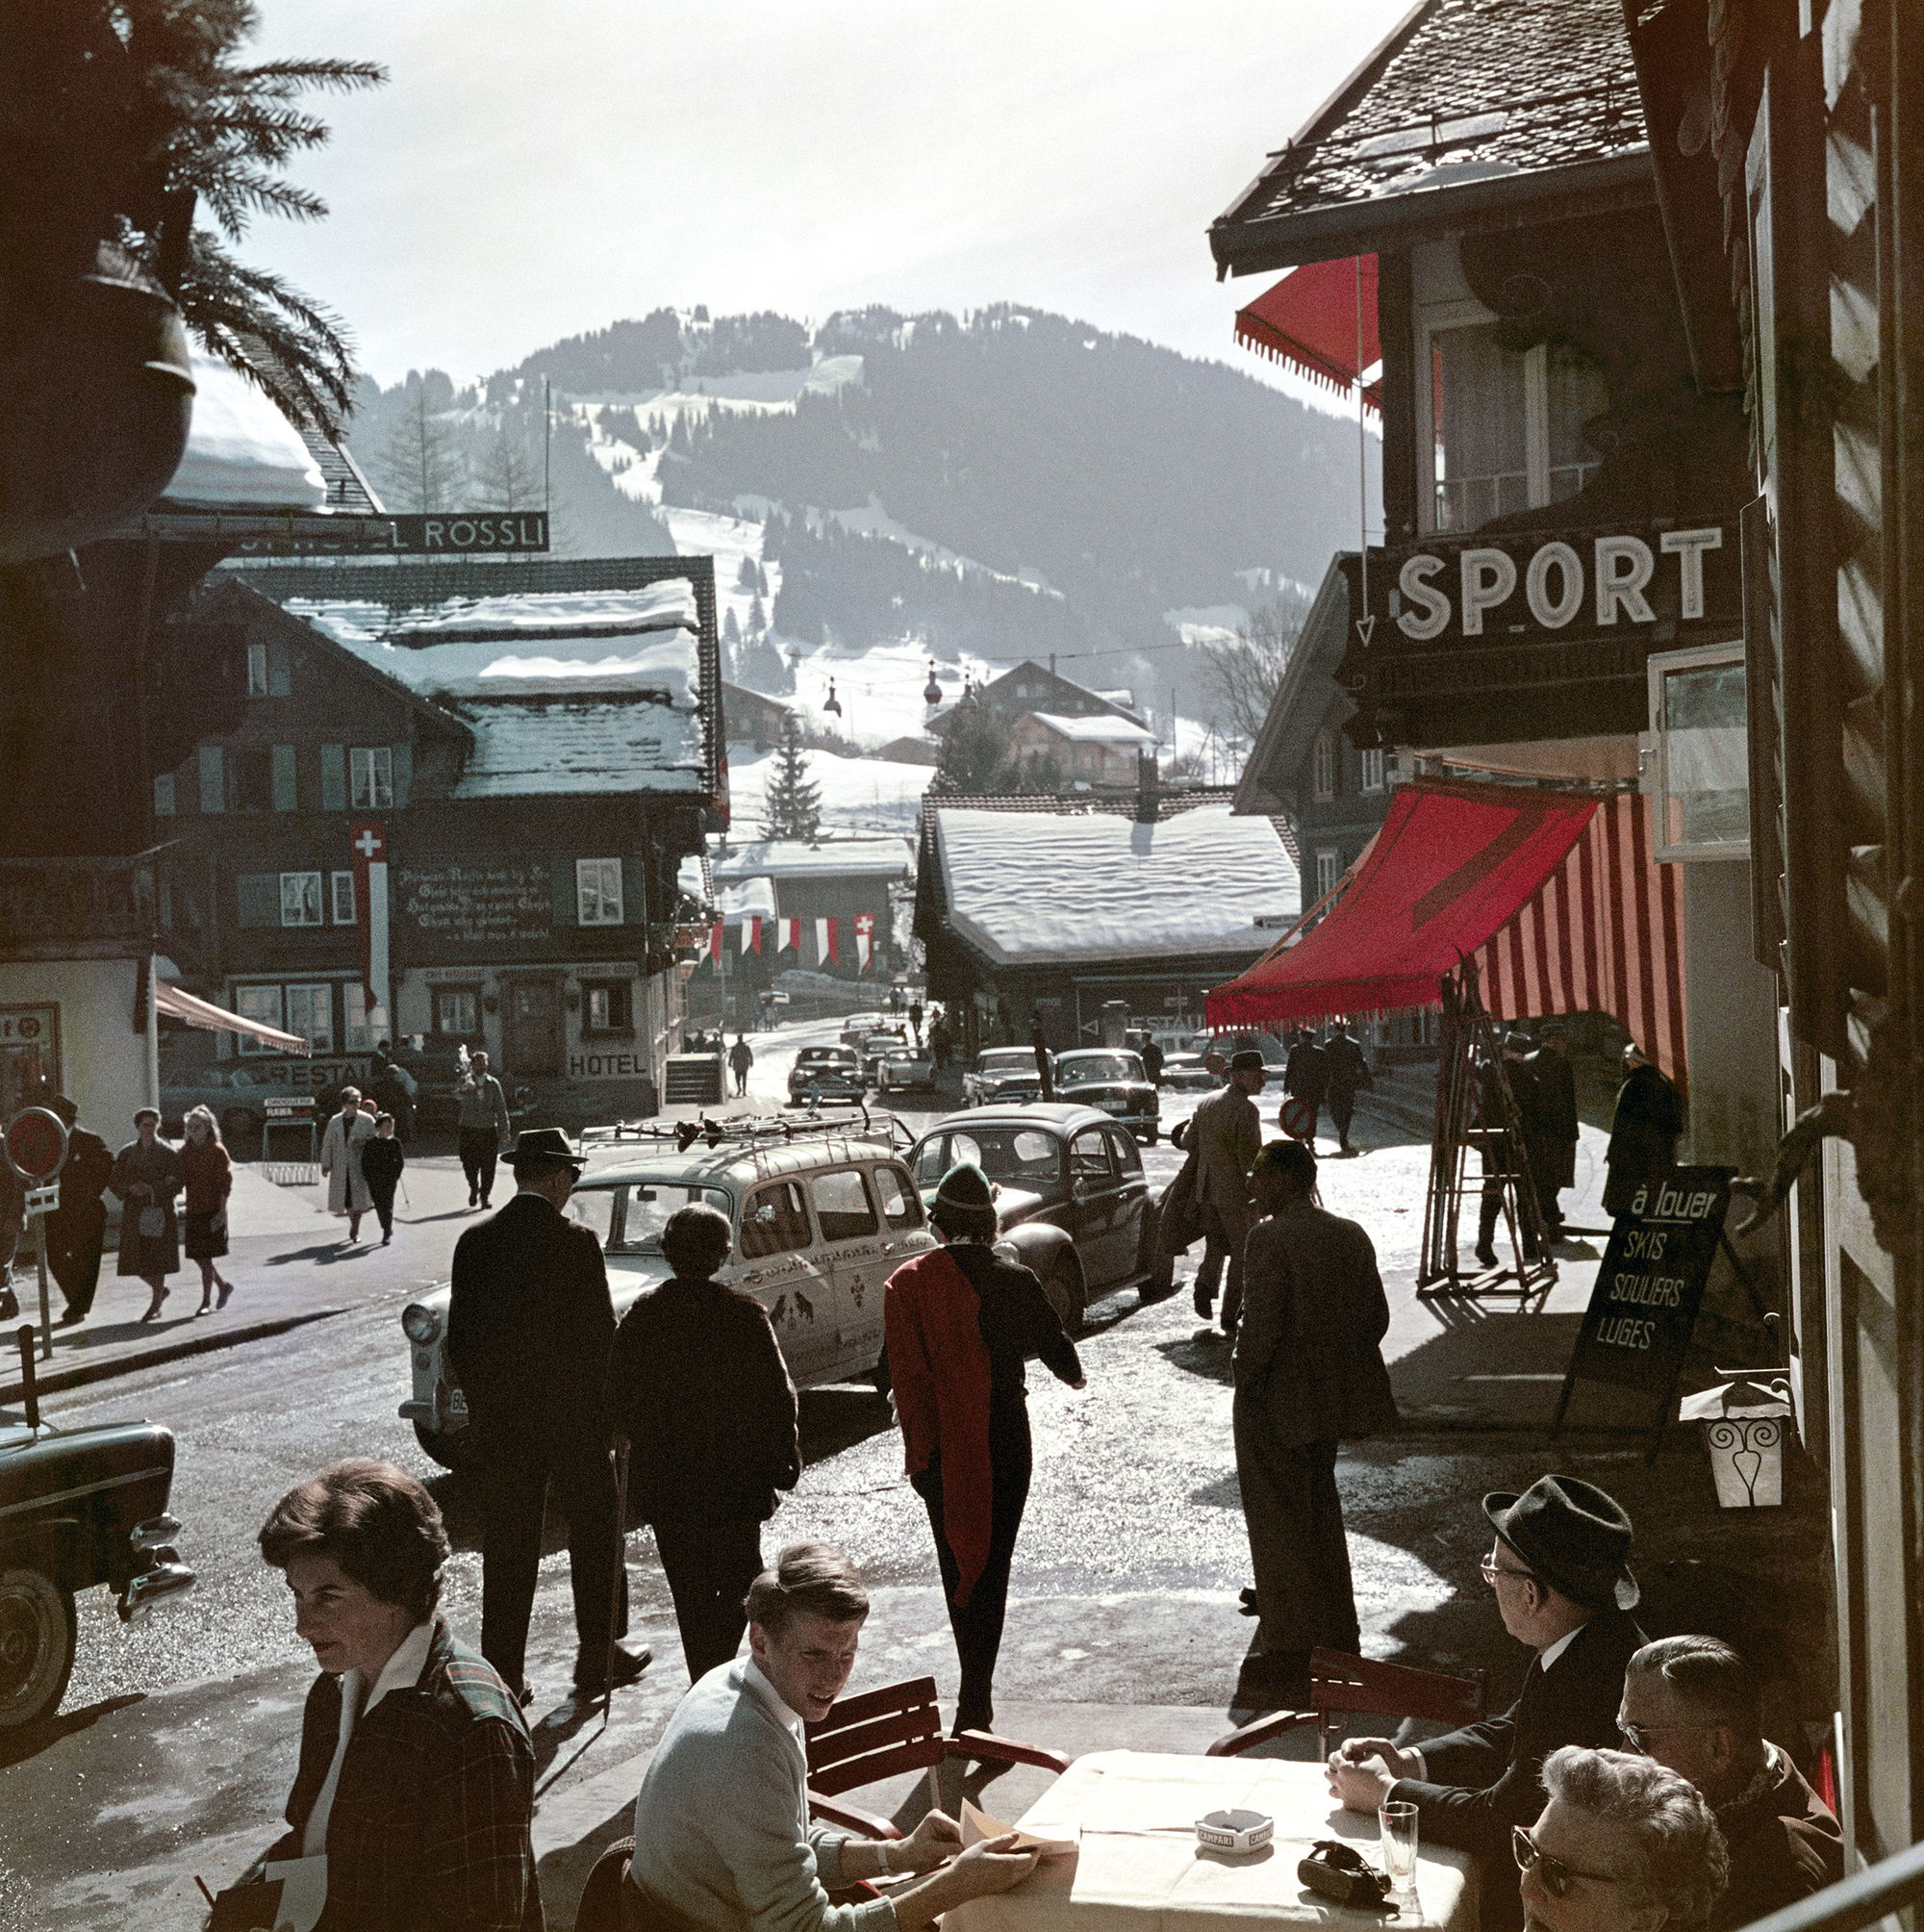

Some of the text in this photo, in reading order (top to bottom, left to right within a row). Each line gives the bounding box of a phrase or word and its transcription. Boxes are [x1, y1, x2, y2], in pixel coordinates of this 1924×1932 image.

[425, 518, 544, 547] RÖSSLI
[1396, 527, 1723, 640] SPORT
[1129, 1014, 1203, 1031] ESTAU
[570, 1054, 646, 1076] HOTEL
[1632, 1181, 1717, 1219] à louer
[1623, 1231, 1668, 1259] SKIS
[1609, 1273, 1684, 1308] SOULIERS
[1597, 1317, 1656, 1350] LUGES
[1199, 1830, 1232, 1846] CAMPARI
